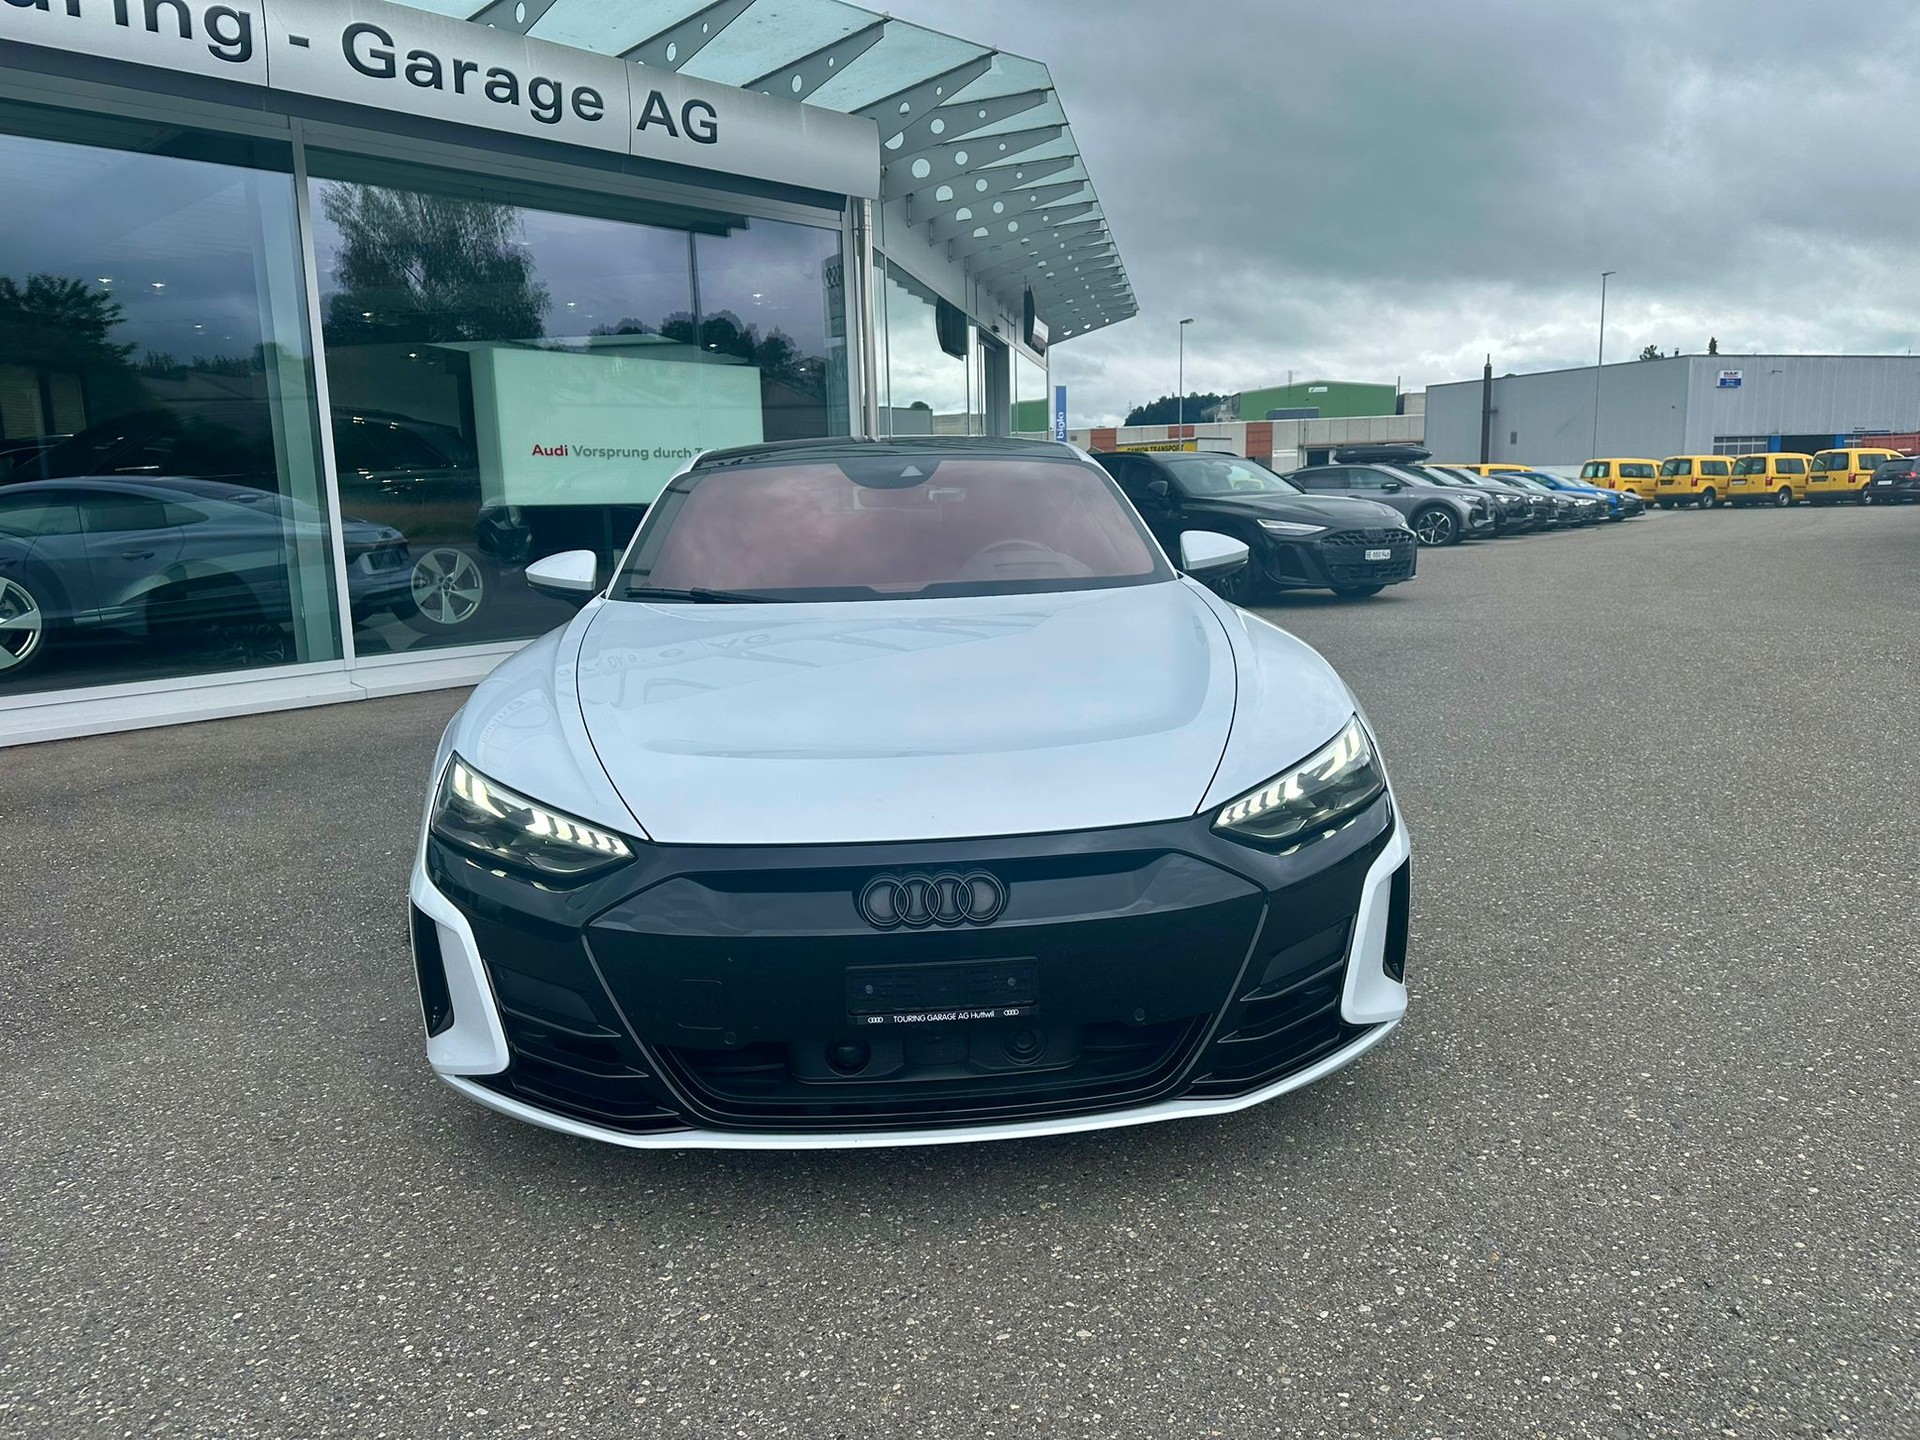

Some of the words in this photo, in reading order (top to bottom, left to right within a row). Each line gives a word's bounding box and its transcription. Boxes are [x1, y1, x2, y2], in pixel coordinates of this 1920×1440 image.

[341, 22, 605, 124] Garage
[635, 89, 720, 144] AG
[1056, 411, 1065, 439] bigla
[532, 443, 569, 457] Audi
[572, 445, 650, 460] Vorsprung
[653, 446, 692, 458] durch
[893, 1015, 926, 1023] TOURING
[927, 1013, 957, 1021] GARAGE
[958, 1011, 970, 1019] AG
[970, 1010, 995, 1019] Huttwil
